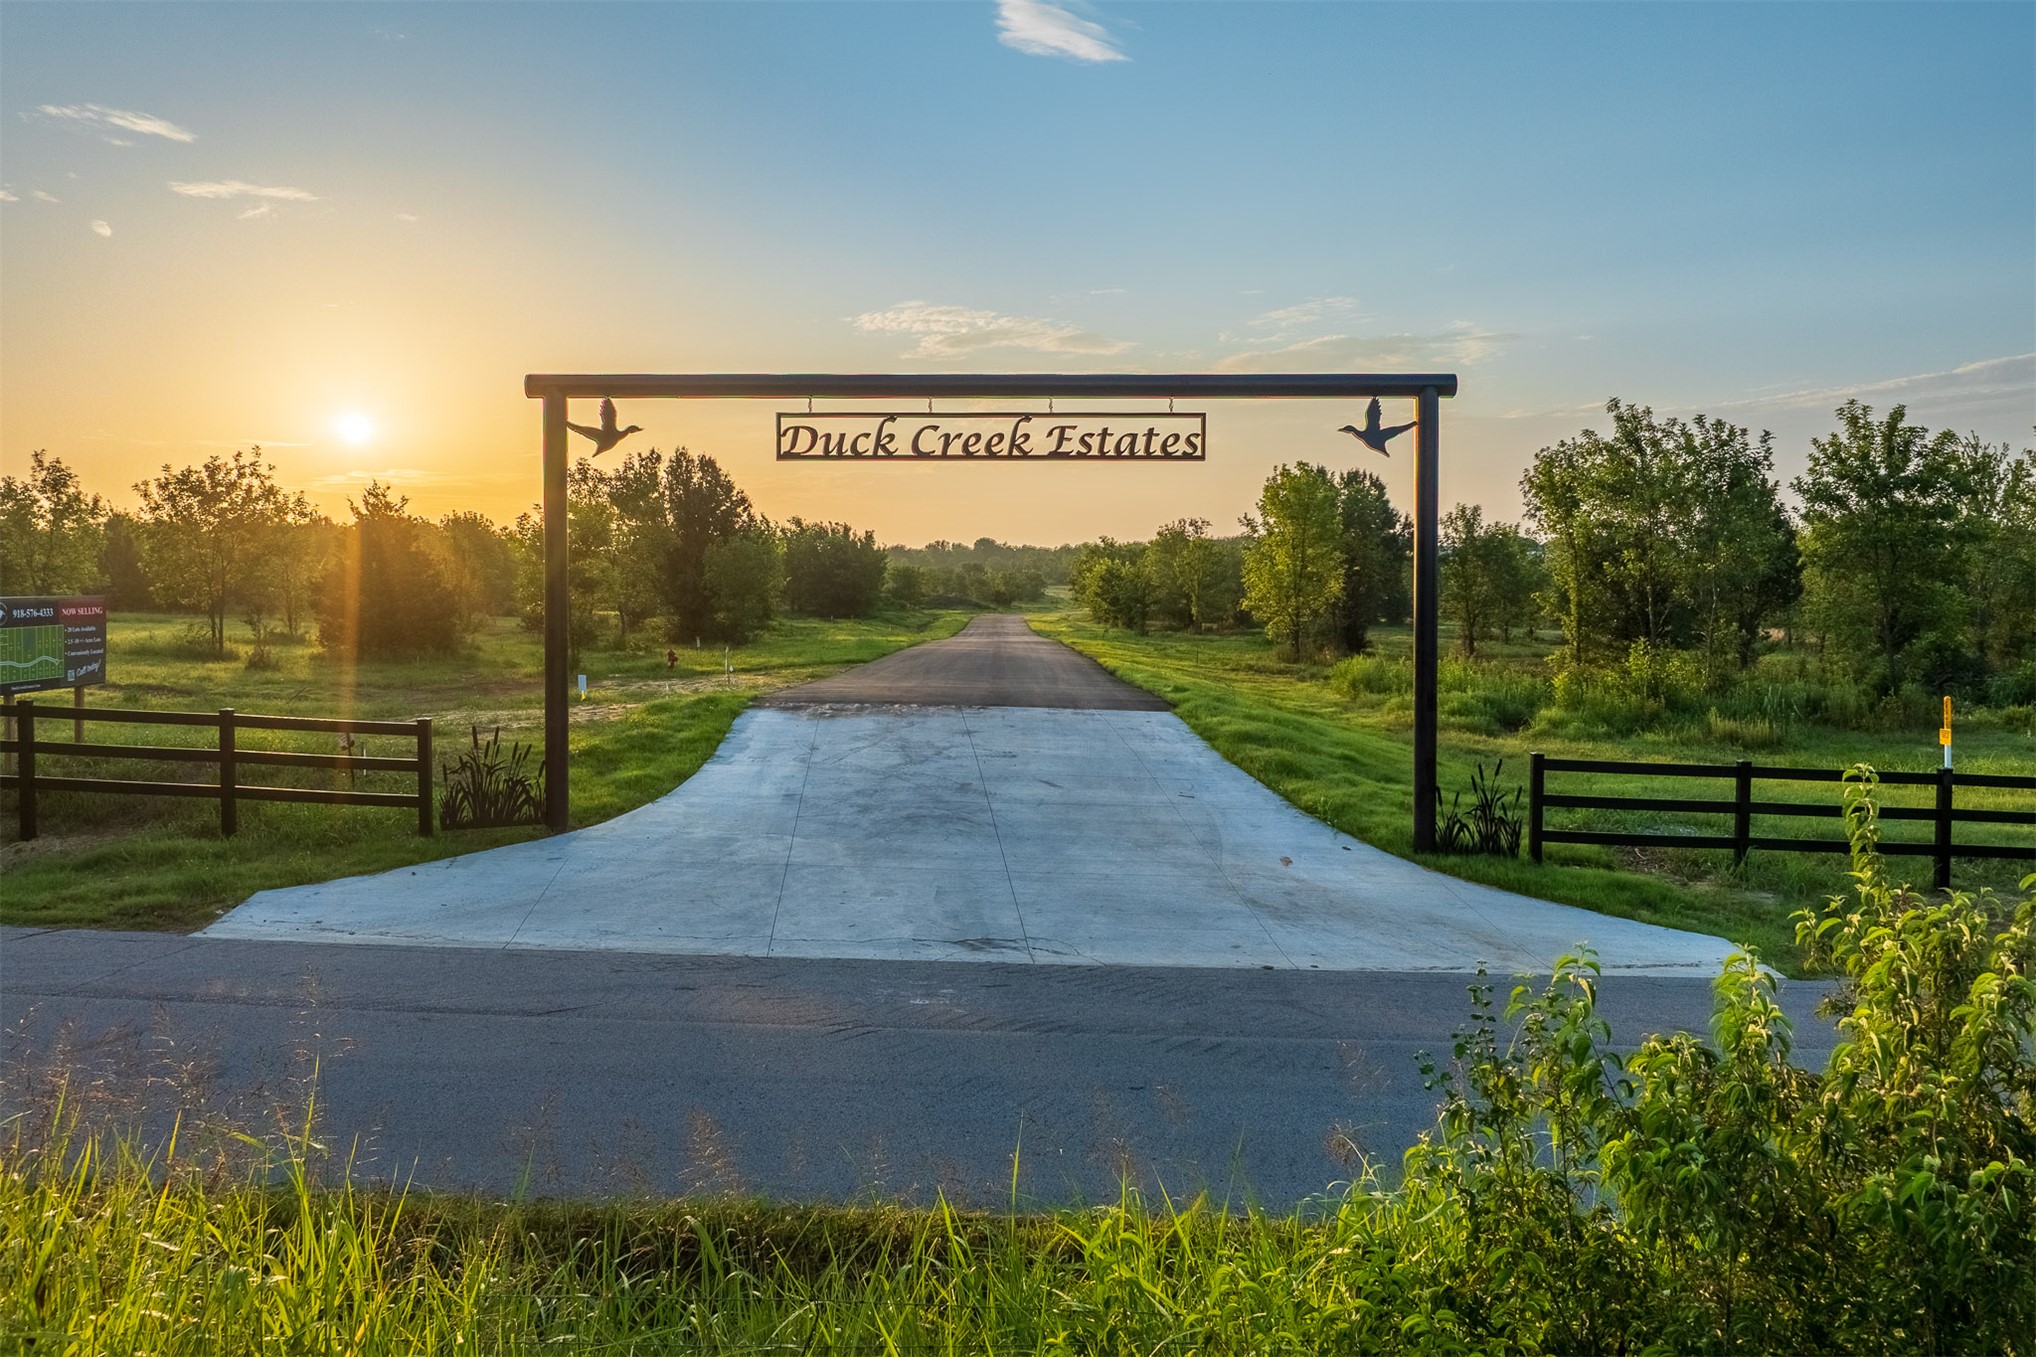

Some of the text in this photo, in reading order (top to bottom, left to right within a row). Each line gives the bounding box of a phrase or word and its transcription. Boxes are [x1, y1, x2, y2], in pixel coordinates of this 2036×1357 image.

[780, 416, 1201, 456] Duck Creek Estates
[12, 608, 54, 618] 918-576-4333
[61, 606, 103, 616] NOW SELLING
